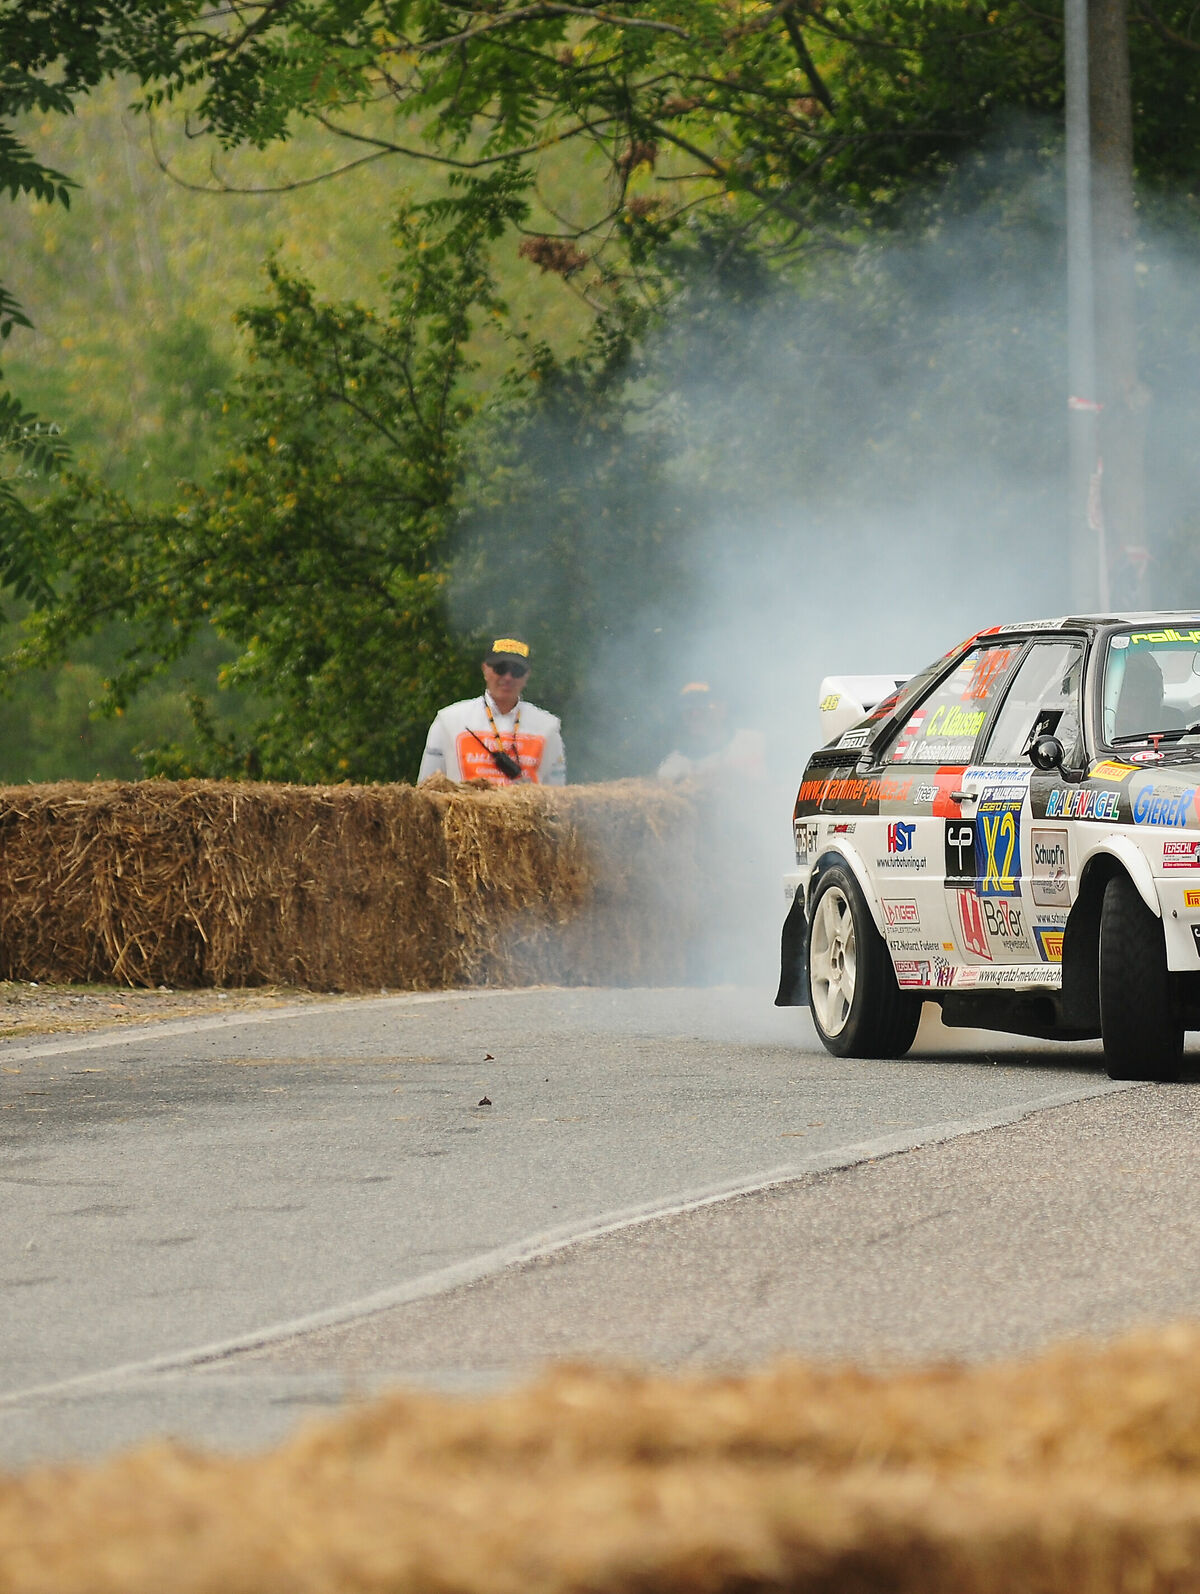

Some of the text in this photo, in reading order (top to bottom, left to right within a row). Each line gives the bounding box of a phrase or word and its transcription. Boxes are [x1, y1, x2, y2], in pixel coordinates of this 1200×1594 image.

[819, 694, 840, 712] 46
[835, 727, 871, 749] PIRELLI
[1096, 763, 1133, 777] PIRELLI
[888, 821, 916, 853] HST
[982, 811, 1016, 892] X2
[1164, 842, 1192, 854] TERSCHL
[876, 856, 927, 871] www.turbotuning.at
[1045, 937, 1064, 956] PIR
[978, 967, 1062, 985] www.gratzl-medizintech
